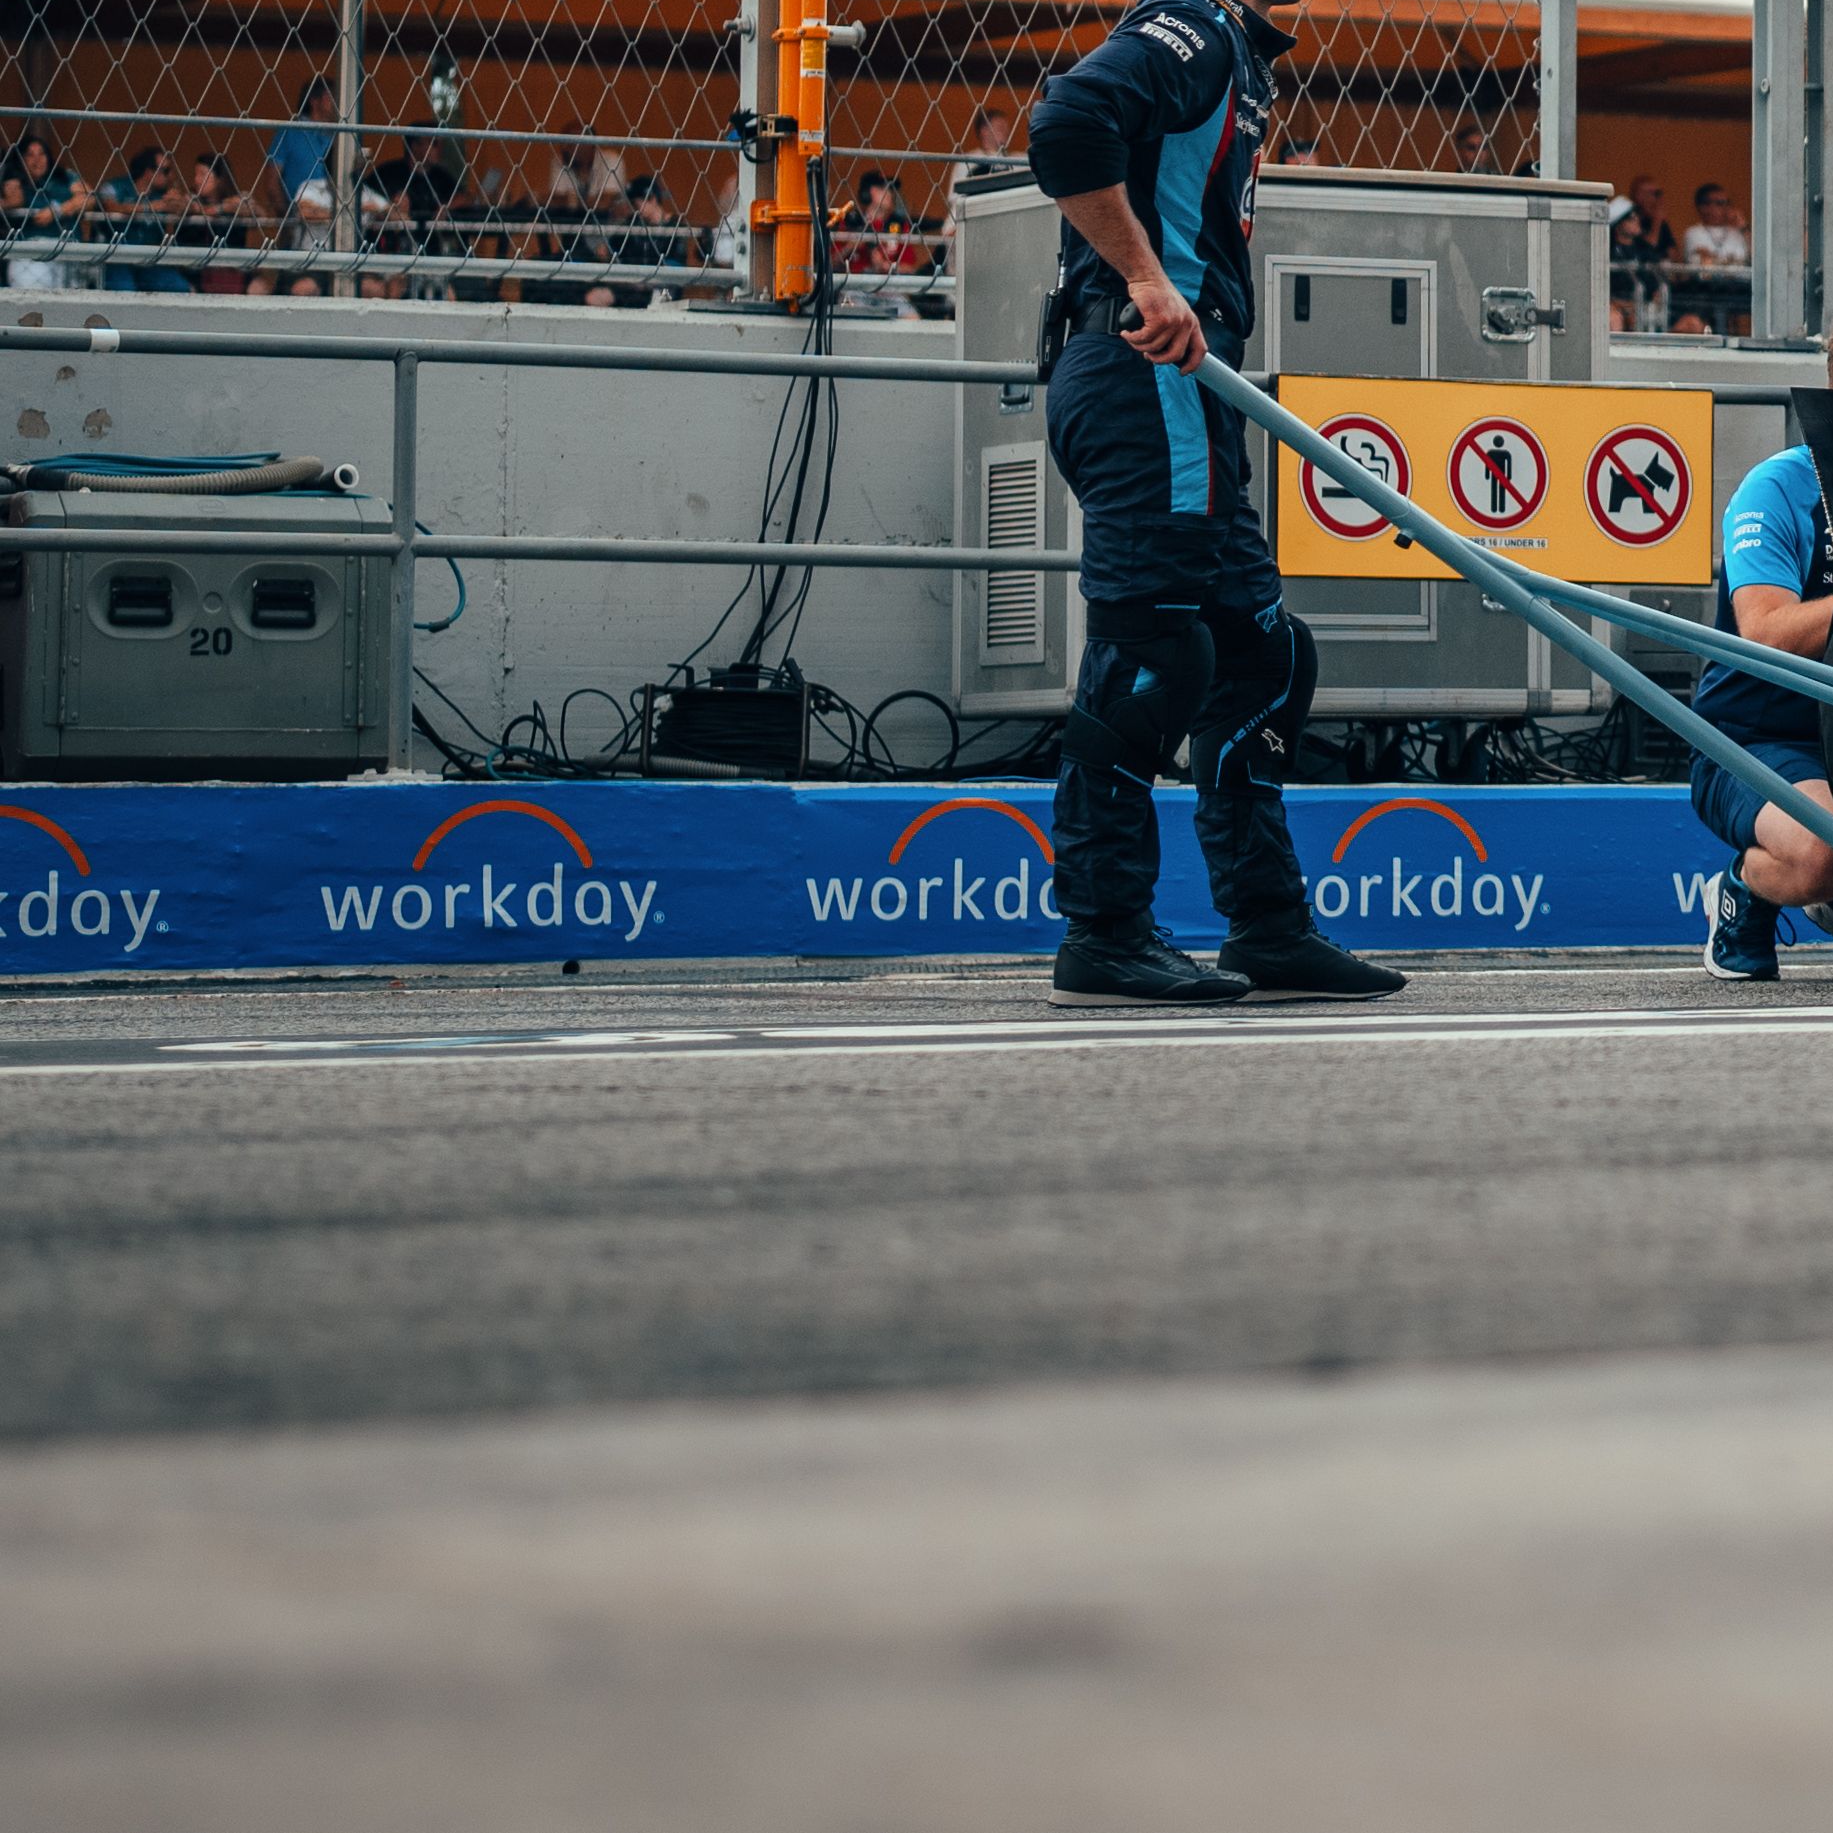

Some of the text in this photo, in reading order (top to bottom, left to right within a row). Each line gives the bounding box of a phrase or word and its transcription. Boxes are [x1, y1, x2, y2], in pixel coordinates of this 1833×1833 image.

[1152, 11, 1206, 51] Acronis
[1488, 538, 1498, 547] 16
[1504, 539, 1534, 547] UNDER
[1536, 539, 1546, 548] 16
[190, 627, 233, 656] 20
[320, 862, 657, 942] workday
[1300, 856, 1545, 931] orkday
